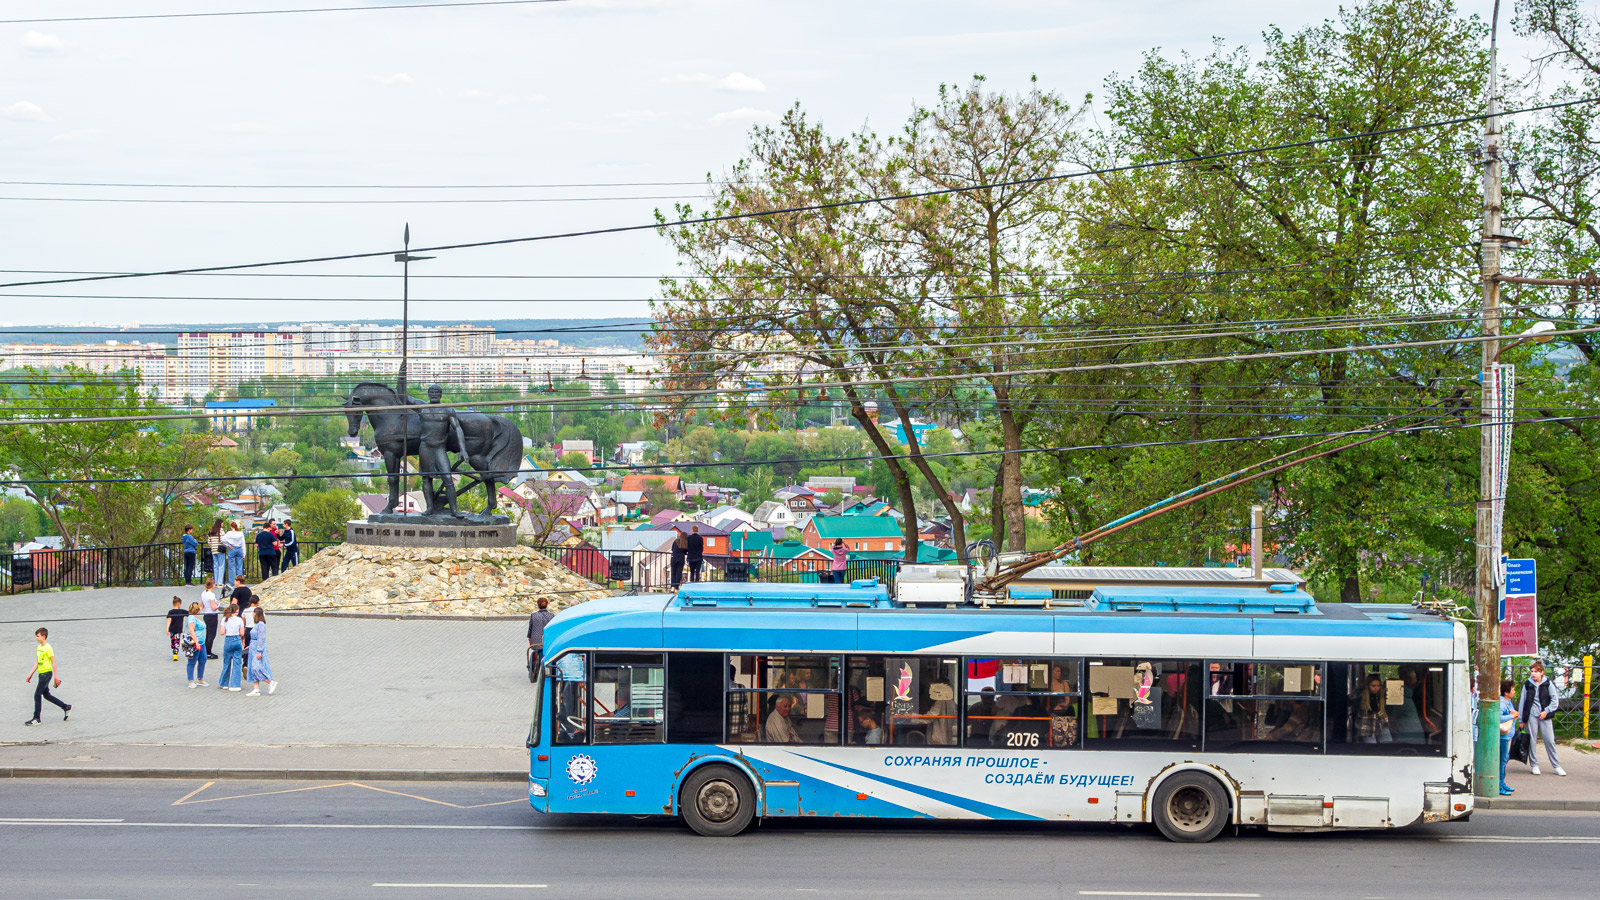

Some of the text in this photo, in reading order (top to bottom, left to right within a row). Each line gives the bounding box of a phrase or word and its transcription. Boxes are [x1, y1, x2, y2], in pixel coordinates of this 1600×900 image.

[1006, 731, 1040, 747] 2076
[884, 755, 962, 767] СОХРАНЯЯ
[965, 756, 1040, 769] ПРОШЛОЕ
[985, 772, 1135, 788] СОЗДАЁМ БУДУЩЕЕ!
